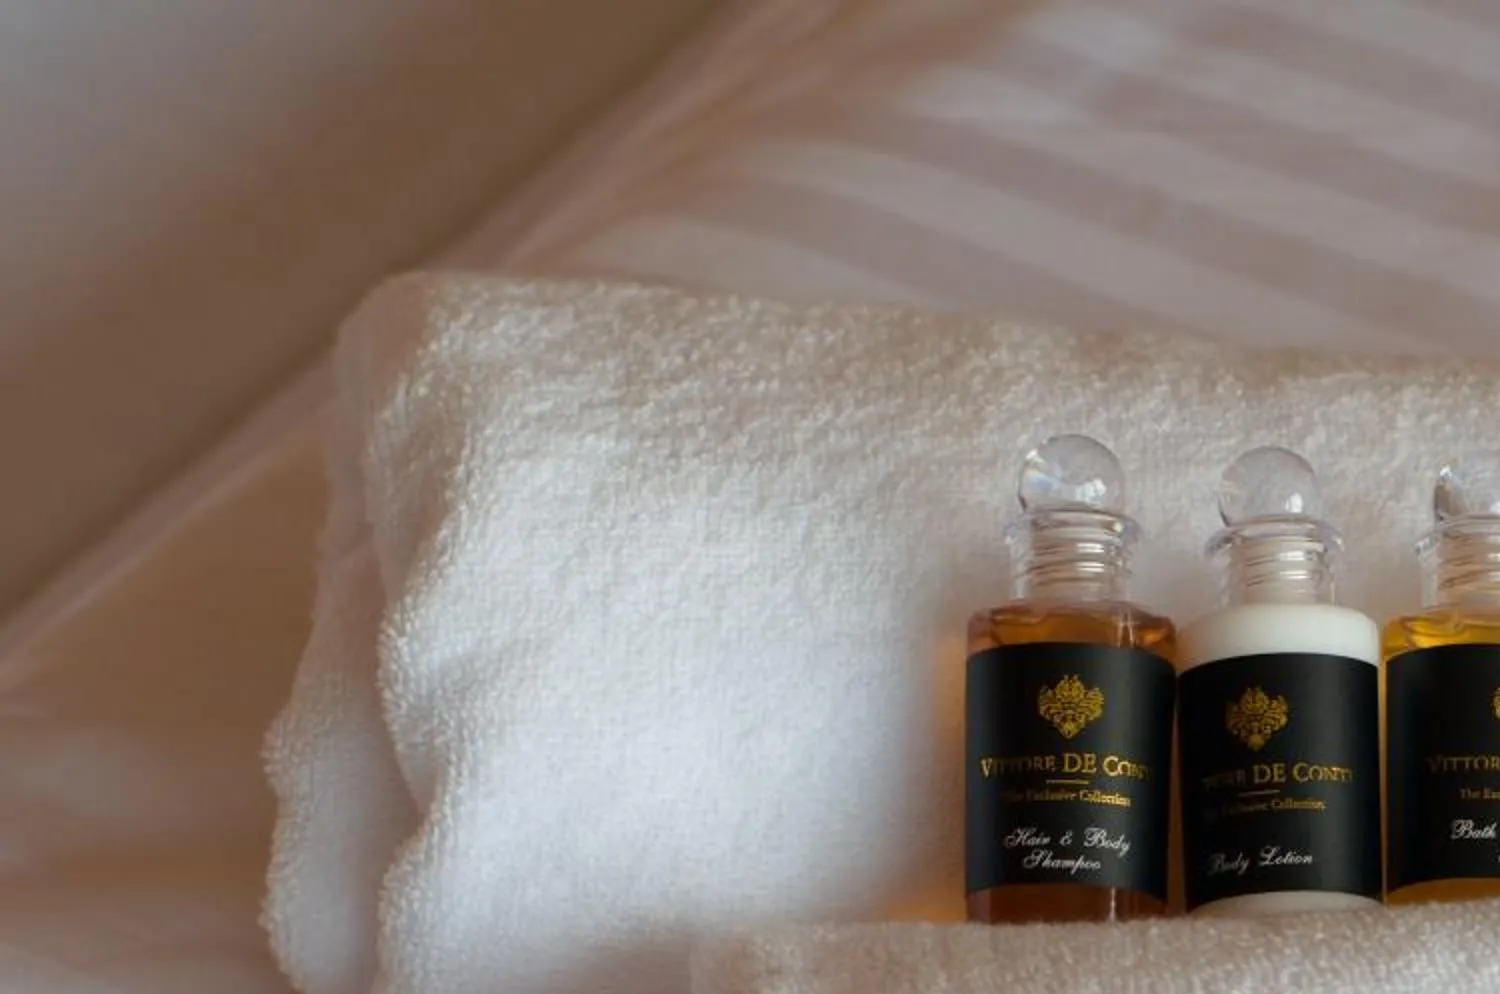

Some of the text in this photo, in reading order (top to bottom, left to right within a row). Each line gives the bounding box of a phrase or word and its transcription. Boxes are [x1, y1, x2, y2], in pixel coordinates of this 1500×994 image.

[1062, 753, 1097, 774] DE
[1252, 762, 1287, 784] DE
[1003, 826, 1132, 858] Hair & Body
[1449, 819, 1498, 841] Bath
[1023, 849, 1102, 875] Shampoo
[1206, 845, 1314, 876] Body Lotion
